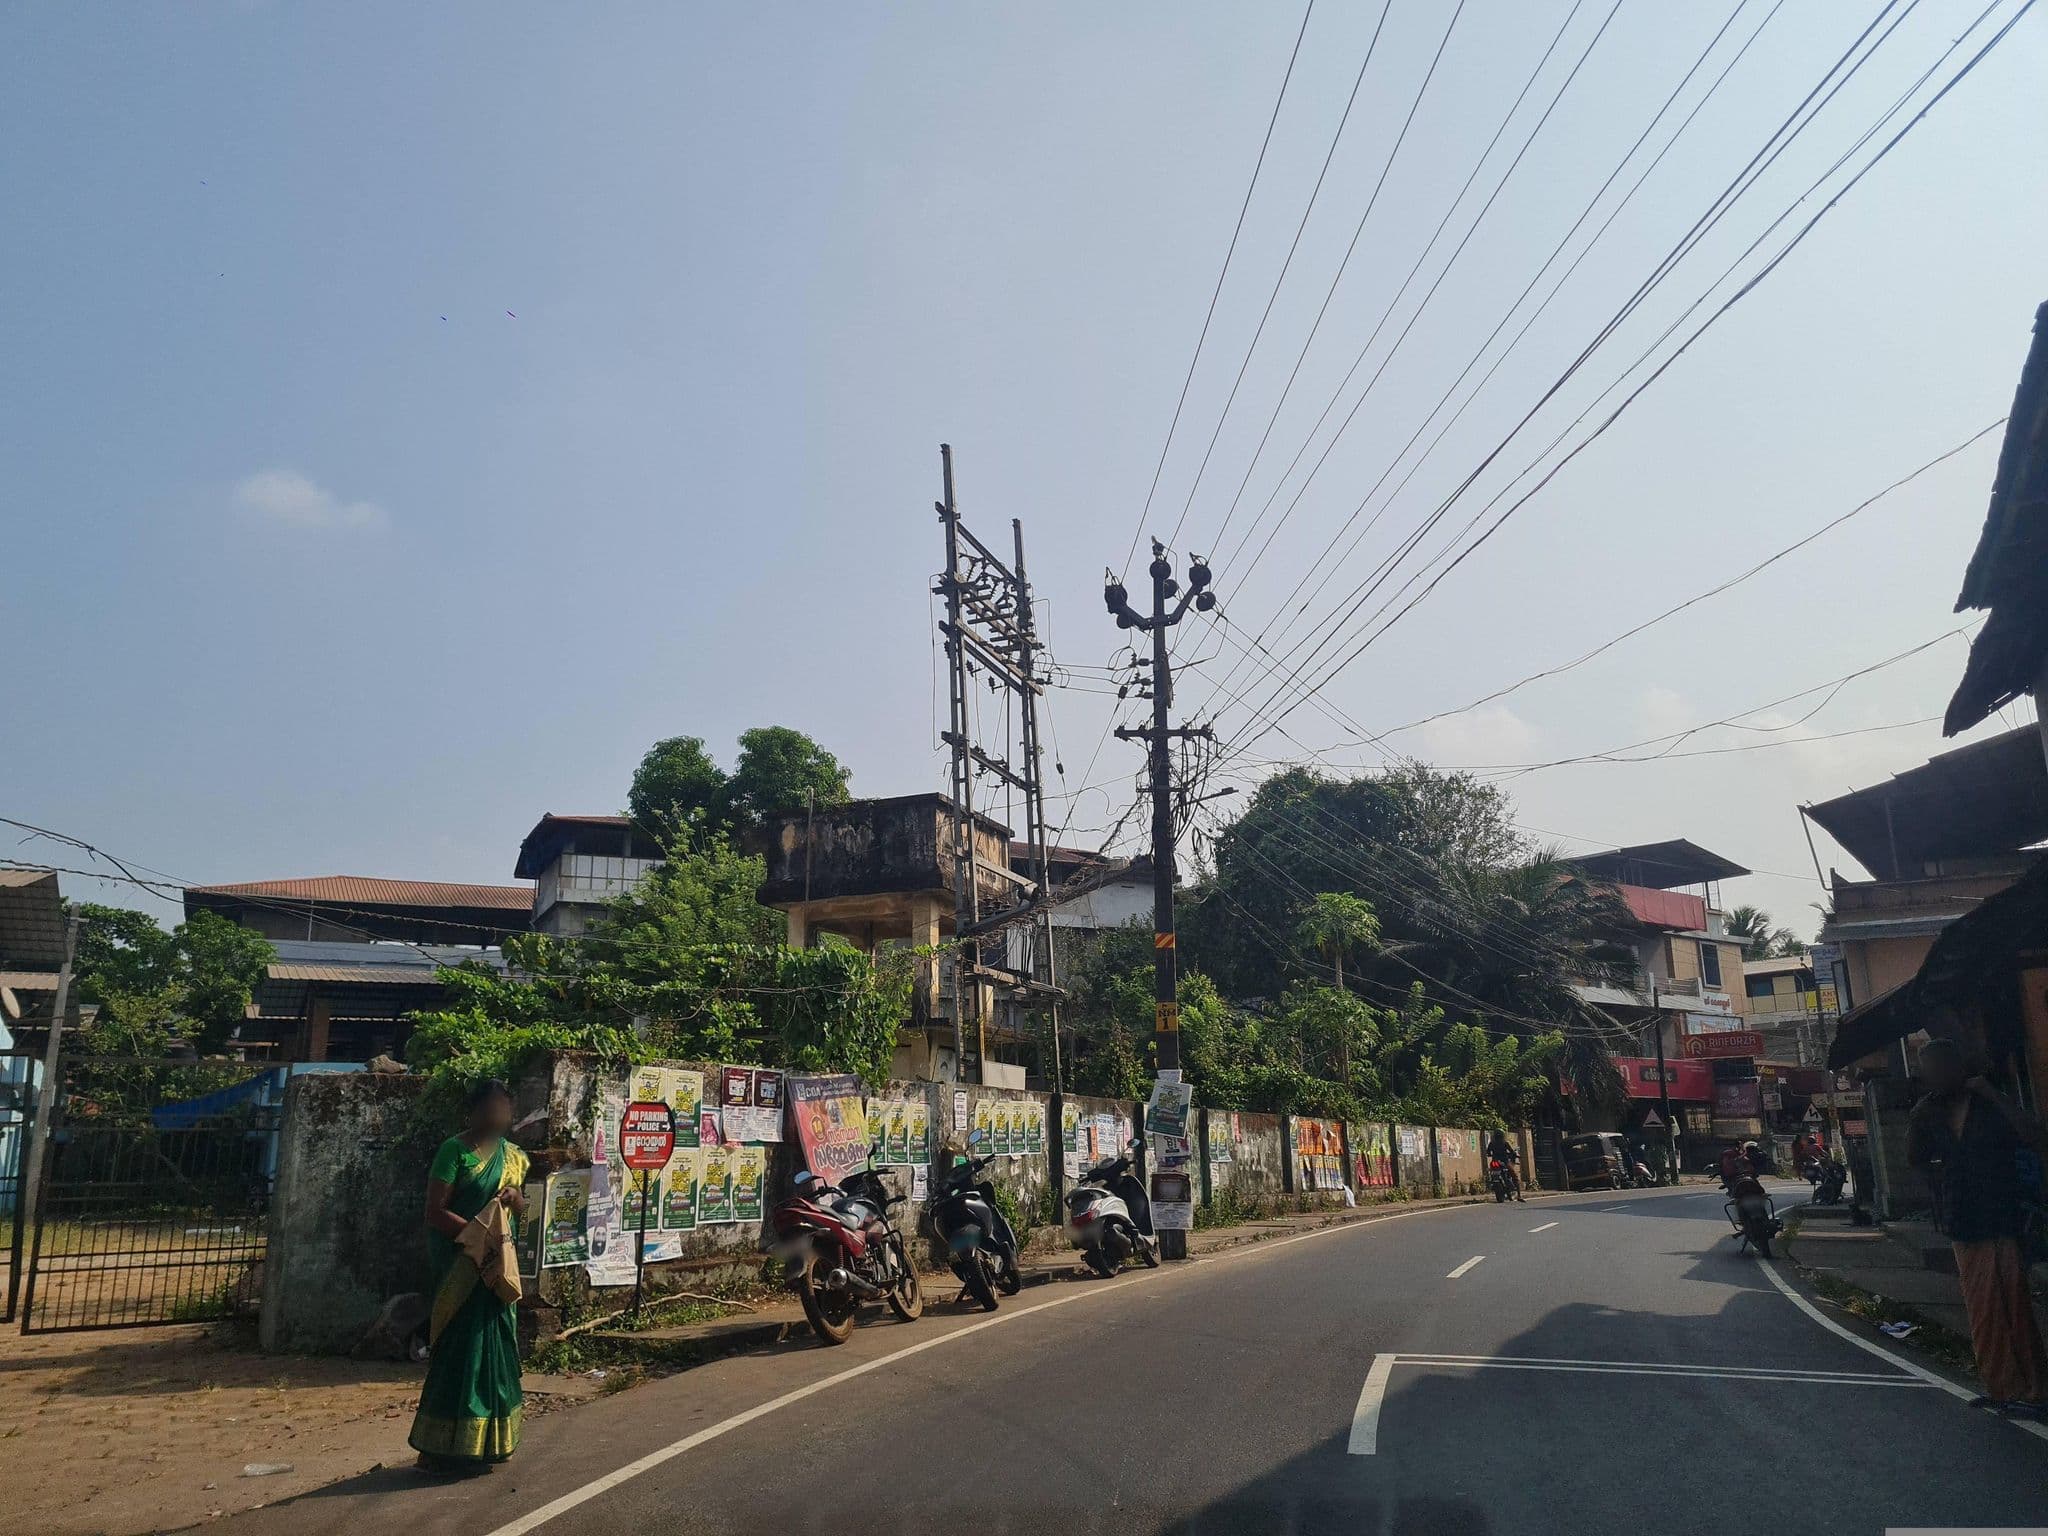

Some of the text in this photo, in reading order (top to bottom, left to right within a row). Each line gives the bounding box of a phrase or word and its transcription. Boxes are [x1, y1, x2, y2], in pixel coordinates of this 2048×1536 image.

[629, 1110, 669, 1122] NO PARKING
[637, 1121, 660, 1131] POLICE
